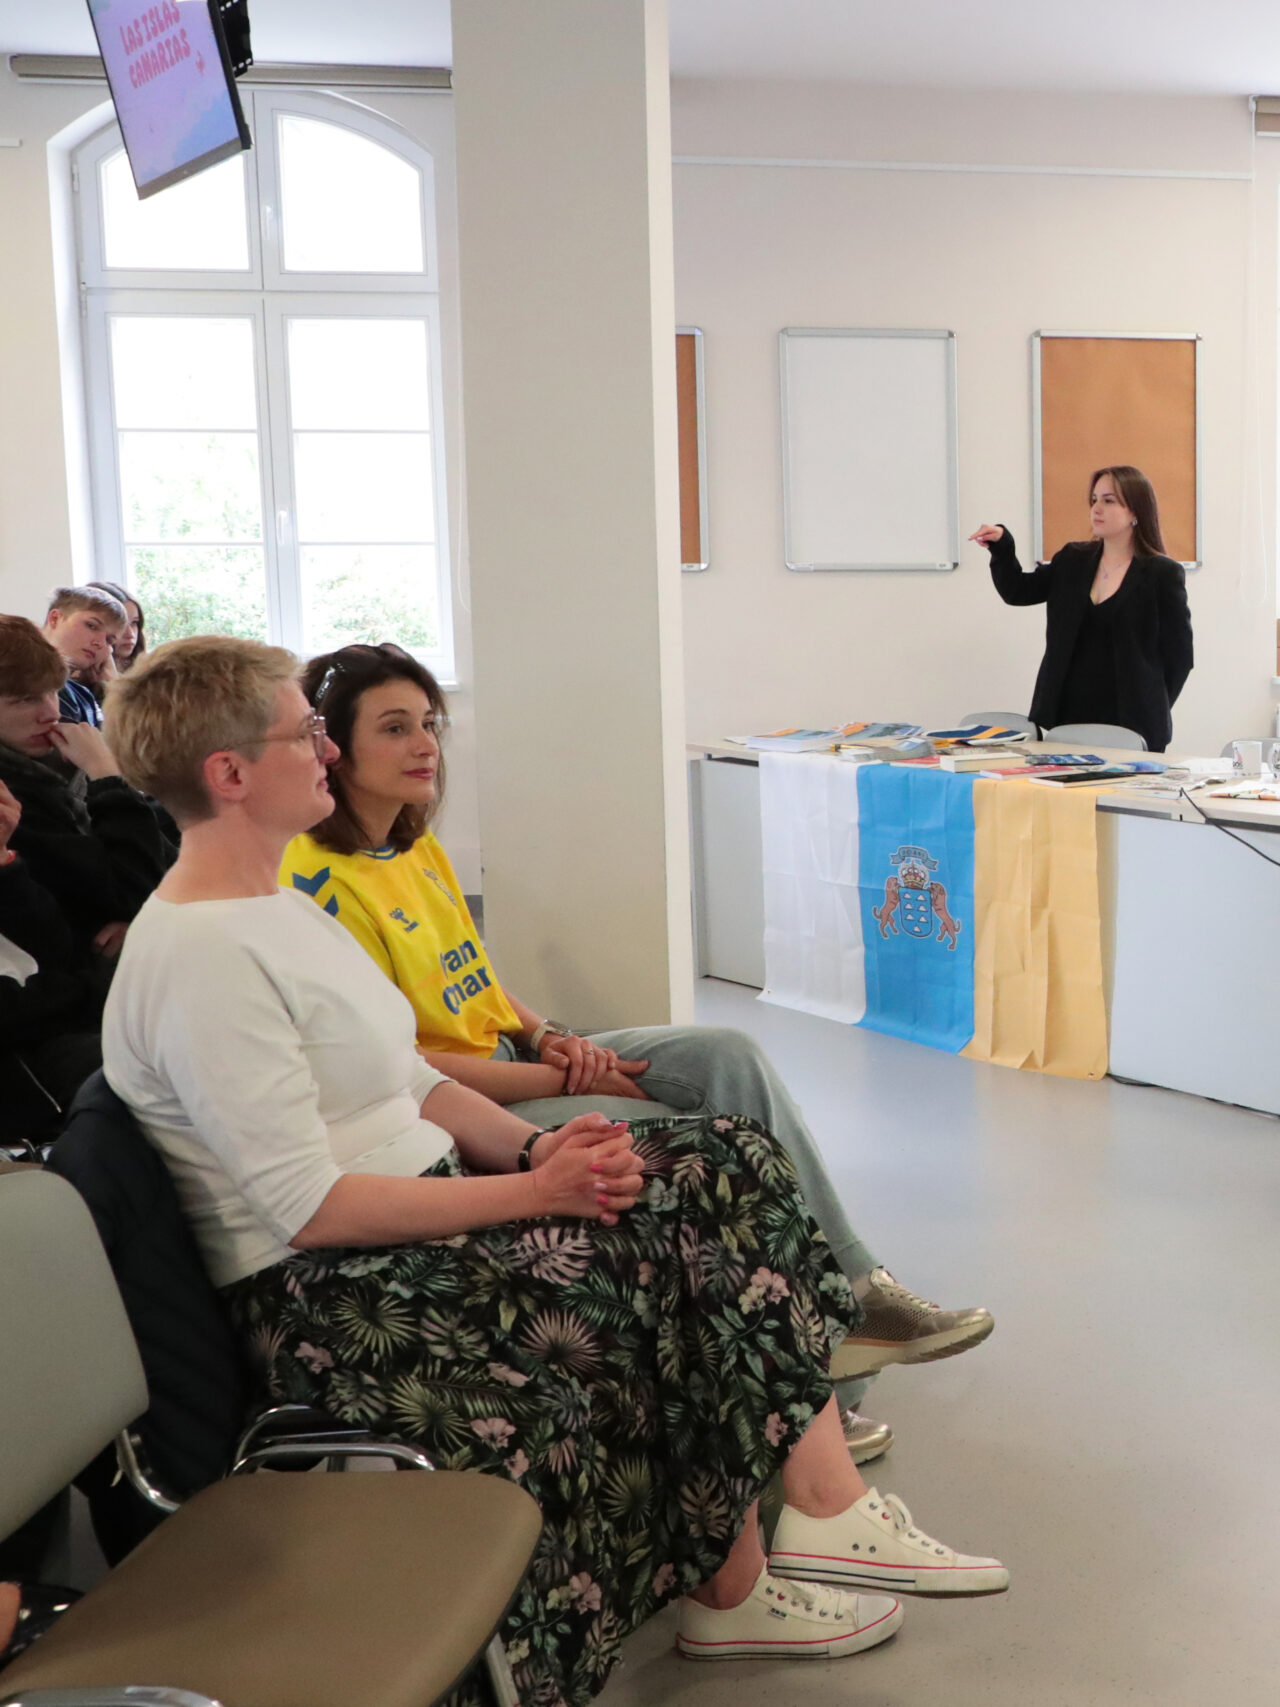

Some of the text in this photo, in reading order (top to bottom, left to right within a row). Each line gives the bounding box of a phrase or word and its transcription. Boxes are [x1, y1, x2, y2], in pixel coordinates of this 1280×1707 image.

[119, 0, 181, 57] LAS ISLAS
[128, 28, 191, 89] CANARIAS
